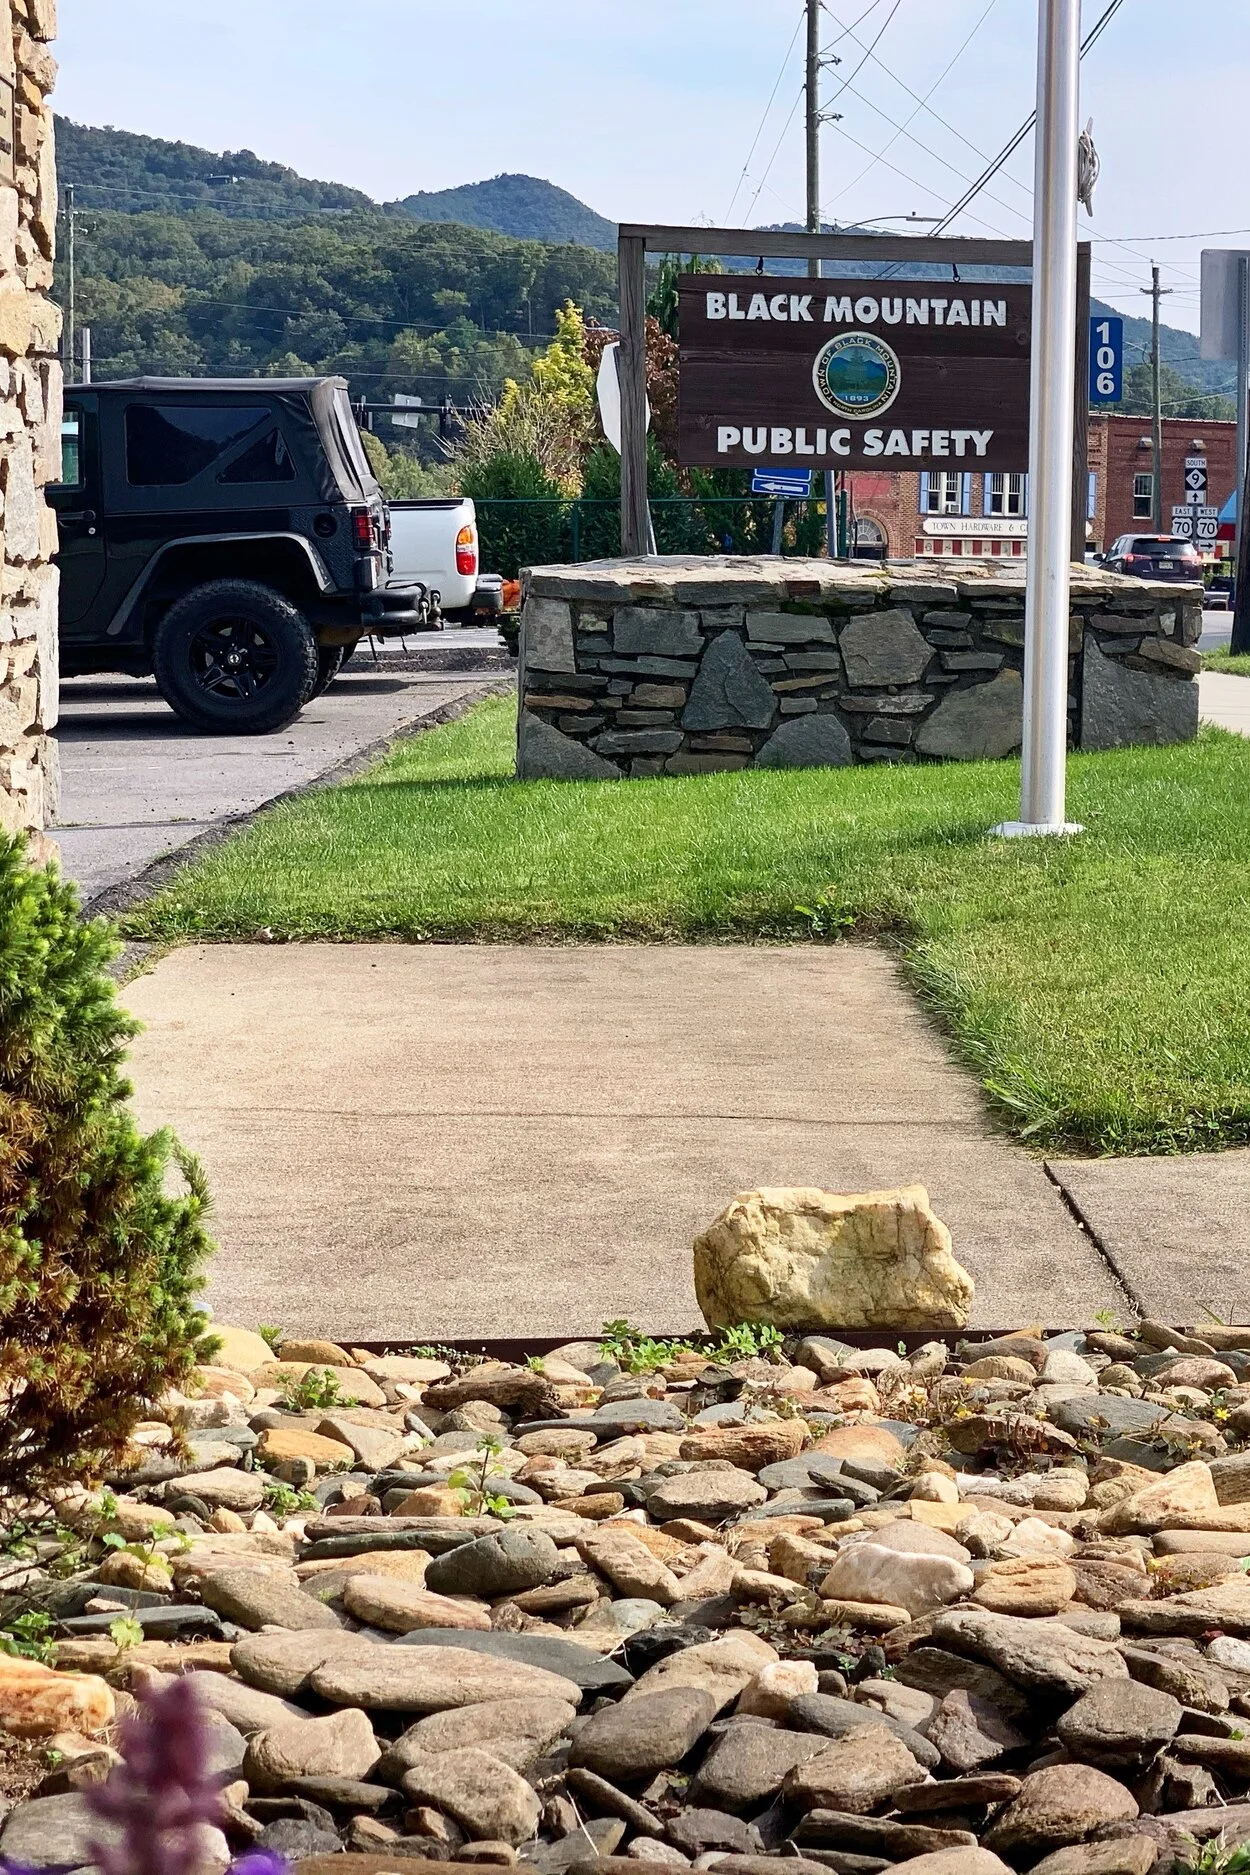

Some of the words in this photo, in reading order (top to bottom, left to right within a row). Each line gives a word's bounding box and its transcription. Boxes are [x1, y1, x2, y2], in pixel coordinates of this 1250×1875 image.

[706, 292, 814, 322] BLACK
[823, 296, 1007, 327] MOUNTAIN
[834, 337, 872, 350] BLACK
[821, 349, 833, 365] OF
[1096, 321, 1115, 395] 106
[875, 345, 898, 402] MOUNTAIN
[817, 369, 833, 402] TOWN
[832, 400, 852, 413] NORTH
[853, 401, 882, 413] CAROLINA
[717, 426, 851, 456] PUBLIC
[862, 428, 994, 457] SAFETY
[1191, 473, 1200, 485] 9
[932, 522, 956, 531] TOWN
[961, 522, 1003, 532] HARDWARE
[1008, 523, 1014, 532] &
[1174, 521, 1190, 534] 70
[1199, 522, 1215, 534] 70
